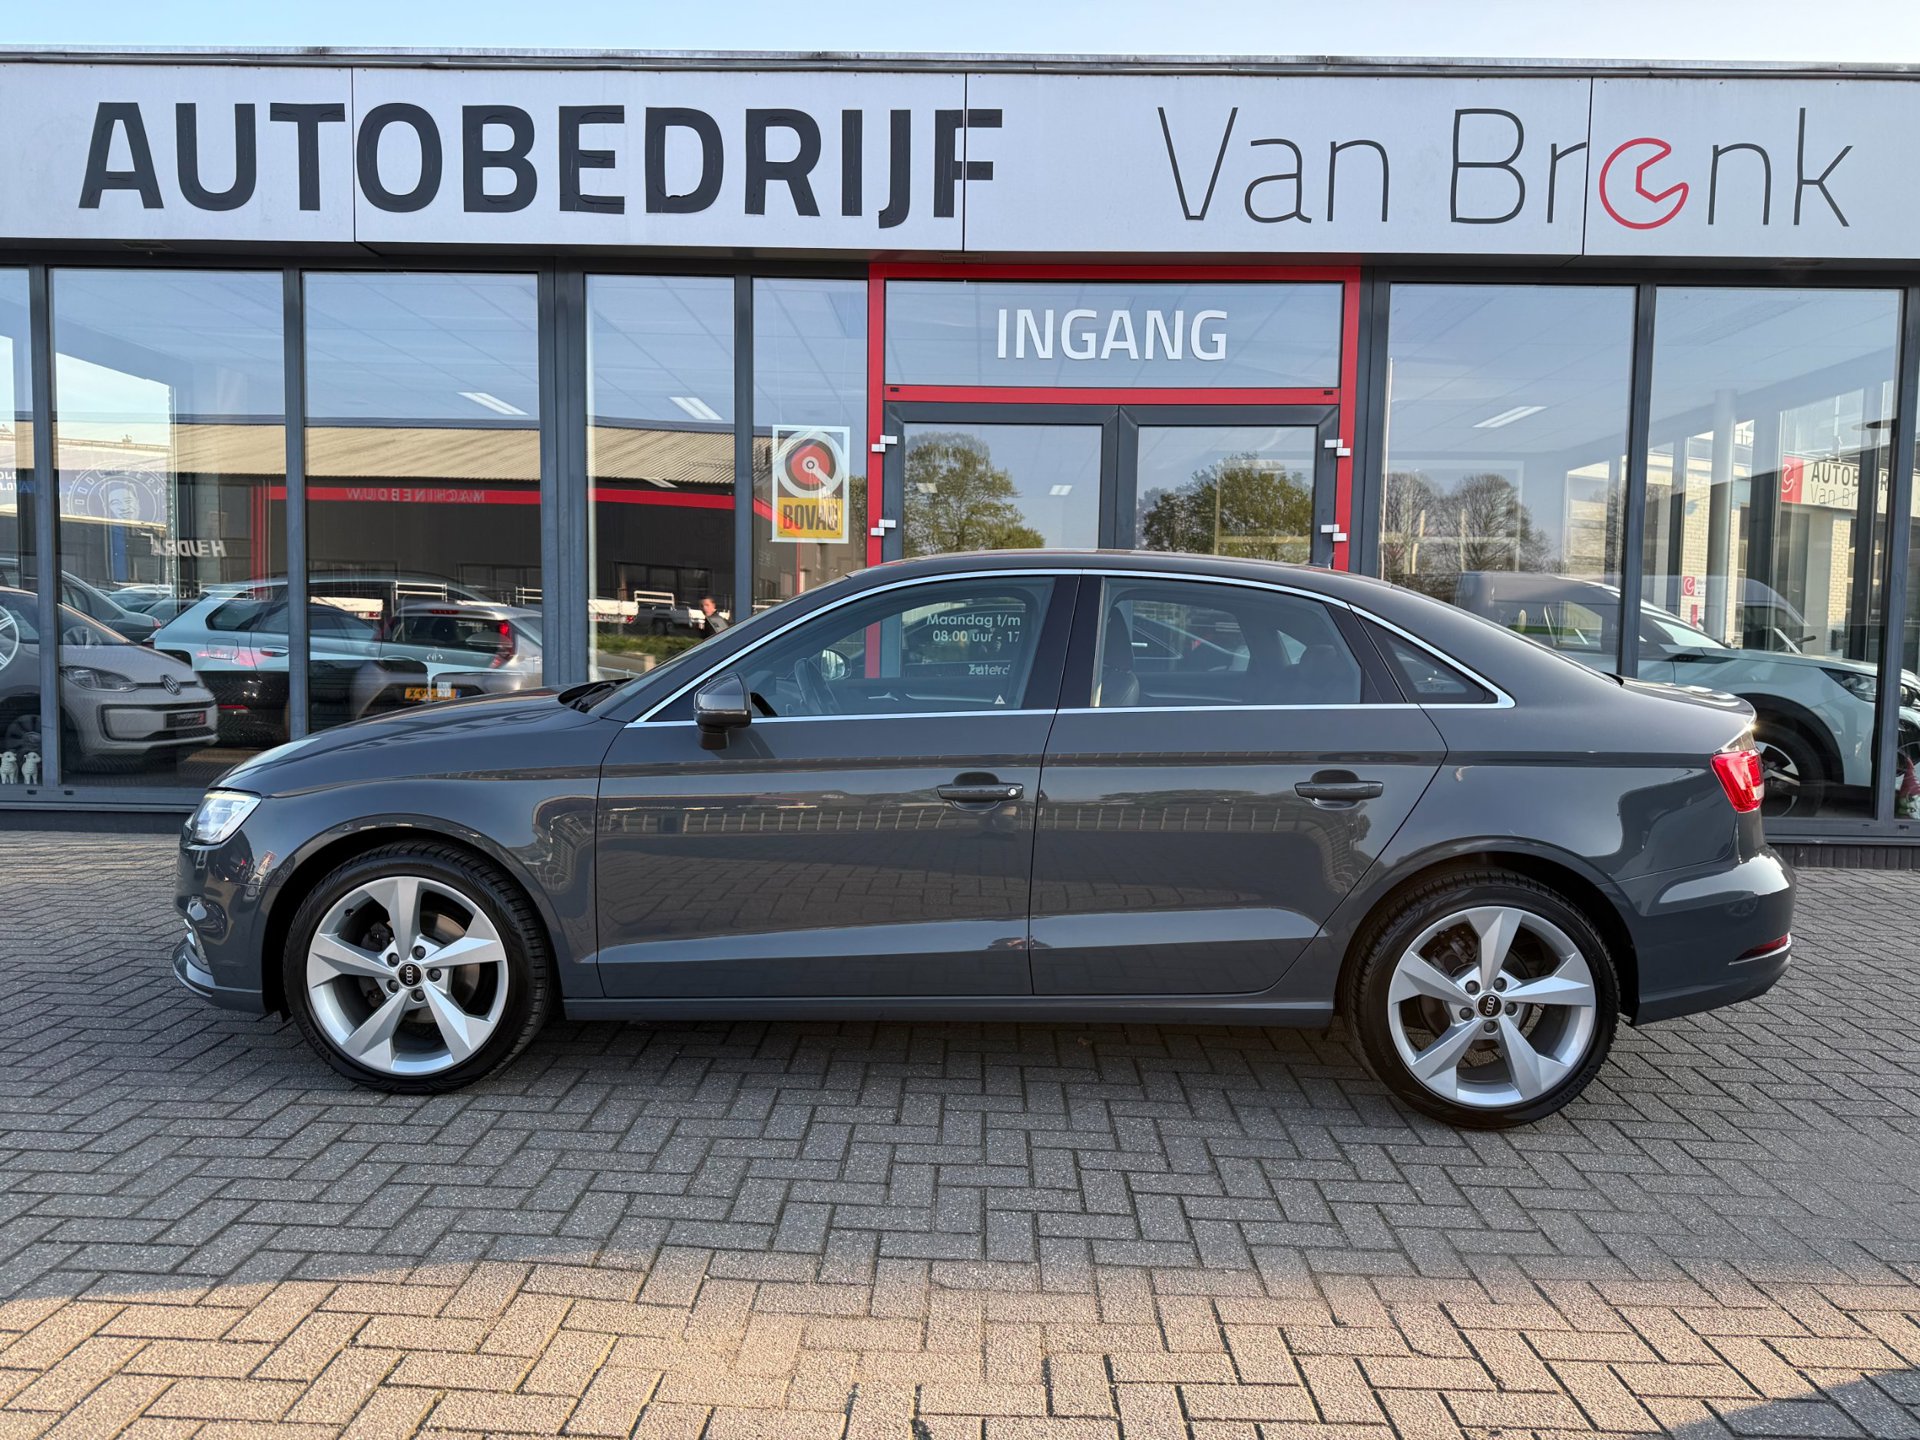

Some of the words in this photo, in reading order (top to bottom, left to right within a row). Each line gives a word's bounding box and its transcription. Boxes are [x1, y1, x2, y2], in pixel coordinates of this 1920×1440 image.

[79, 102, 1002, 228] AUTOBEDRIJF
[1158, 107, 1389, 223] Van
[997, 309, 1228, 361] INGANG
[783, 503, 838, 531] BOVAG
[926, 614, 993, 627] Maandag
[997, 614, 1021, 627] t/m
[932, 630, 968, 642] 08.00
[972, 632, 994, 642] uur
